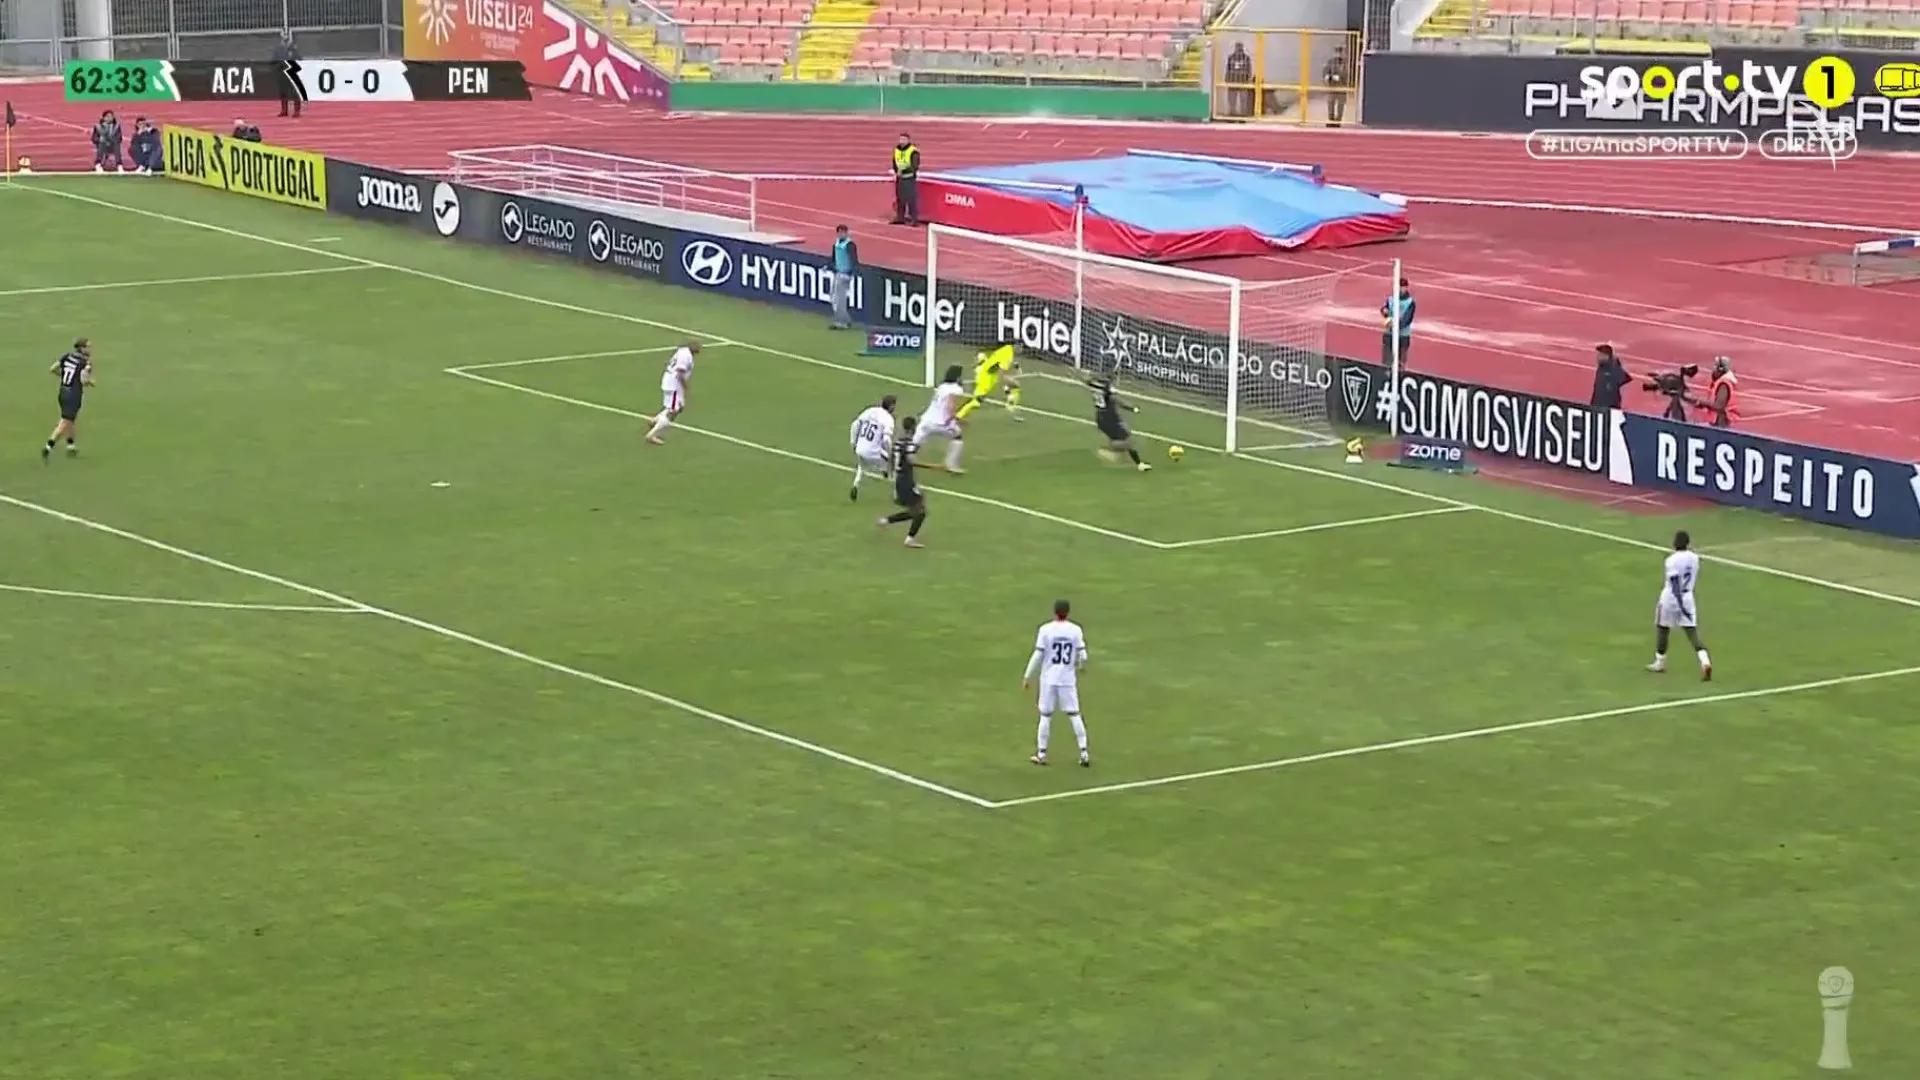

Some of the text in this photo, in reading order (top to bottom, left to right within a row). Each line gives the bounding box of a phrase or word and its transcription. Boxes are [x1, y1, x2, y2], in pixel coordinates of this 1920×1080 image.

[169, 132, 320, 202] LIGA PORTUGAL
[944, 192, 976, 209] DIMA
[527, 235, 573, 253] RESTAURANTE
[614, 255, 661, 275] RESTAURANTE
[884, 278, 964, 333] Haer
[873, 331, 920, 348] zome
[1137, 331, 1224, 368] PALÁCIO
[1270, 359, 1333, 390] GELO
[1136, 361, 1200, 386] SHOPPING
[1375, 376, 1604, 472] #SOMOSVISEU
[1407, 443, 1462, 461] zome
[1657, 432, 1875, 518] RESPEITO
[1051, 642, 1073, 665] 33
